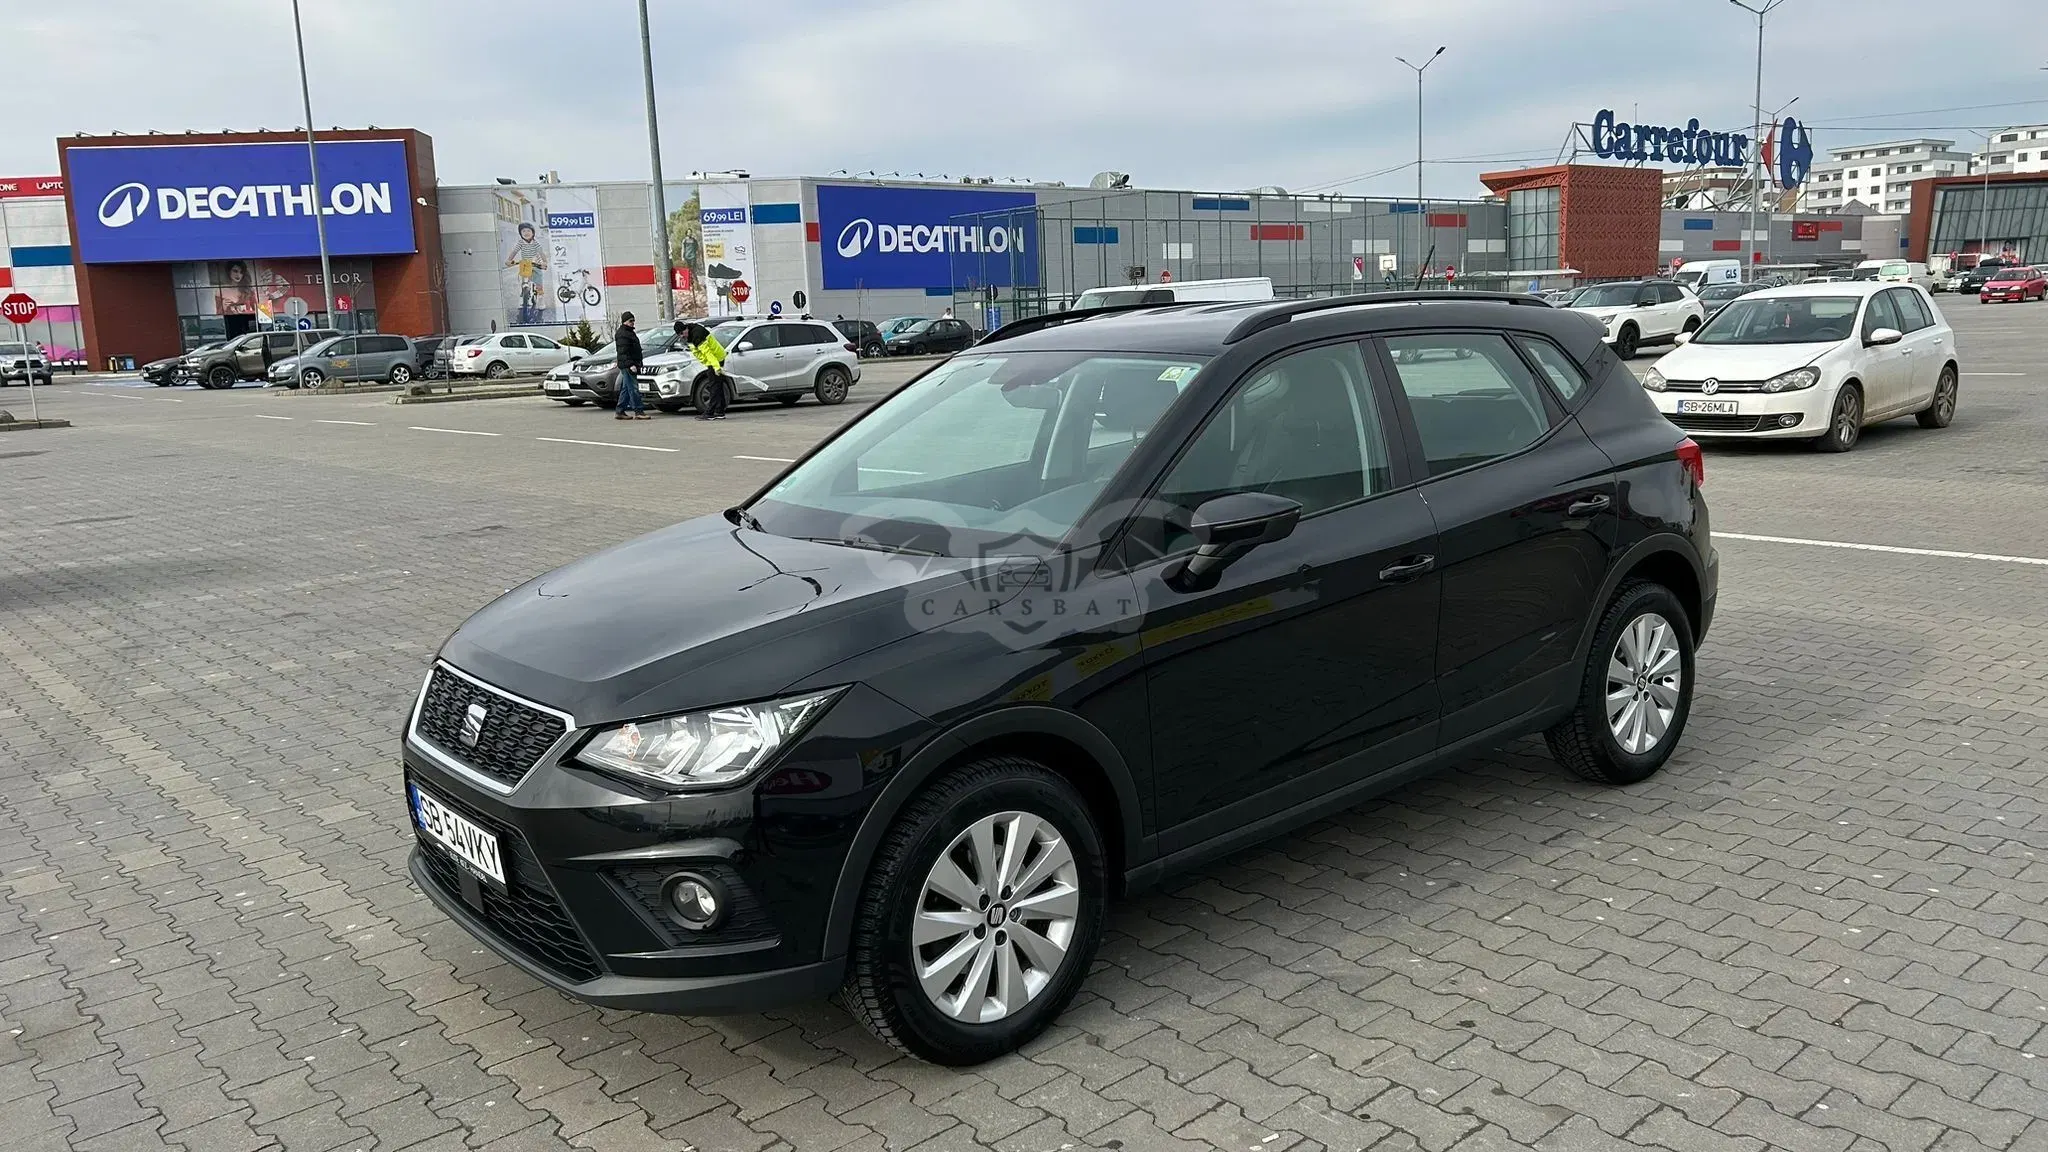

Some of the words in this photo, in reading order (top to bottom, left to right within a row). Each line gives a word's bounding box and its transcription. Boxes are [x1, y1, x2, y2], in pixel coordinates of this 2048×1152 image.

[1592, 109, 1748, 167] Carrefour
[156, 182, 392, 220] DECATHLON
[578, 216, 593, 225] LEI
[727, 211, 743, 221] LEI
[877, 224, 1025, 253] DECATHLON
[304, 273, 362, 284] TELOR
[1725, 268, 1737, 279] GLS
[3, 301, 35, 316] STOP
[420, 795, 443, 836] SB
[443, 810, 499, 875] 54VKY
